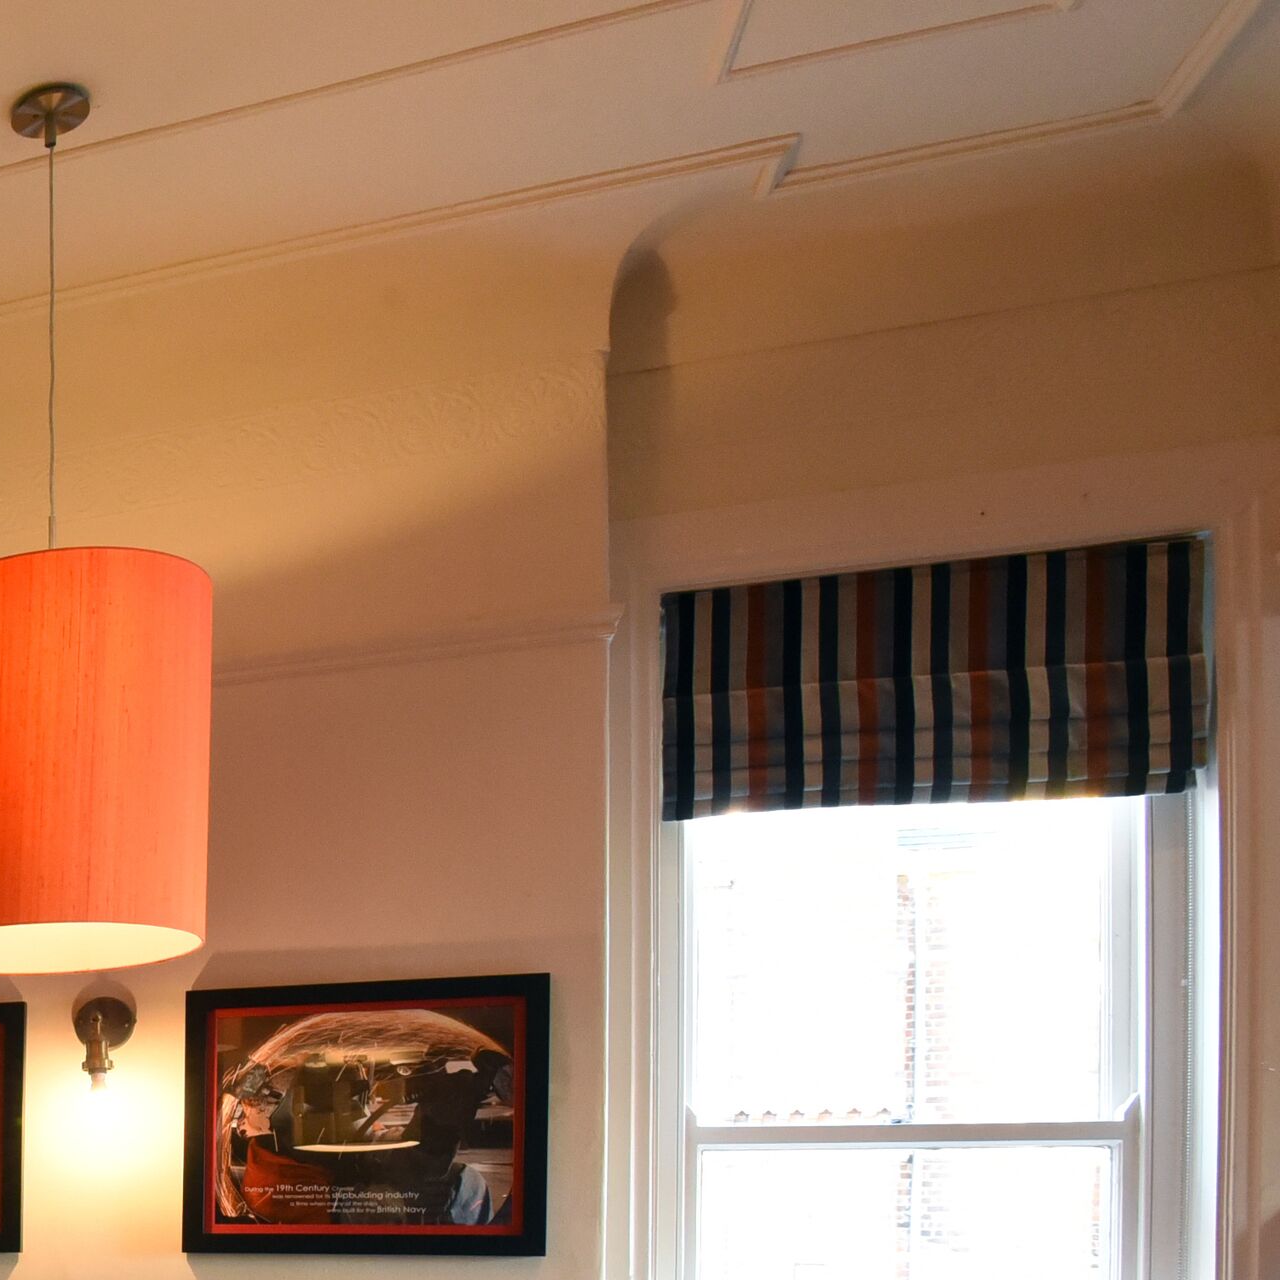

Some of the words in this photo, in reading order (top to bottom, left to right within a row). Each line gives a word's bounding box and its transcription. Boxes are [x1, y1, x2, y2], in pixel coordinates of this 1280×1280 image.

[276, 1184, 294, 1192] 19th
[295, 1184, 330, 1193] Century
[331, 1191, 383, 1201] shipbuilding
[385, 1191, 420, 1200] industry
[376, 1205, 401, 1214] British
[403, 1206, 427, 1214] Navy
